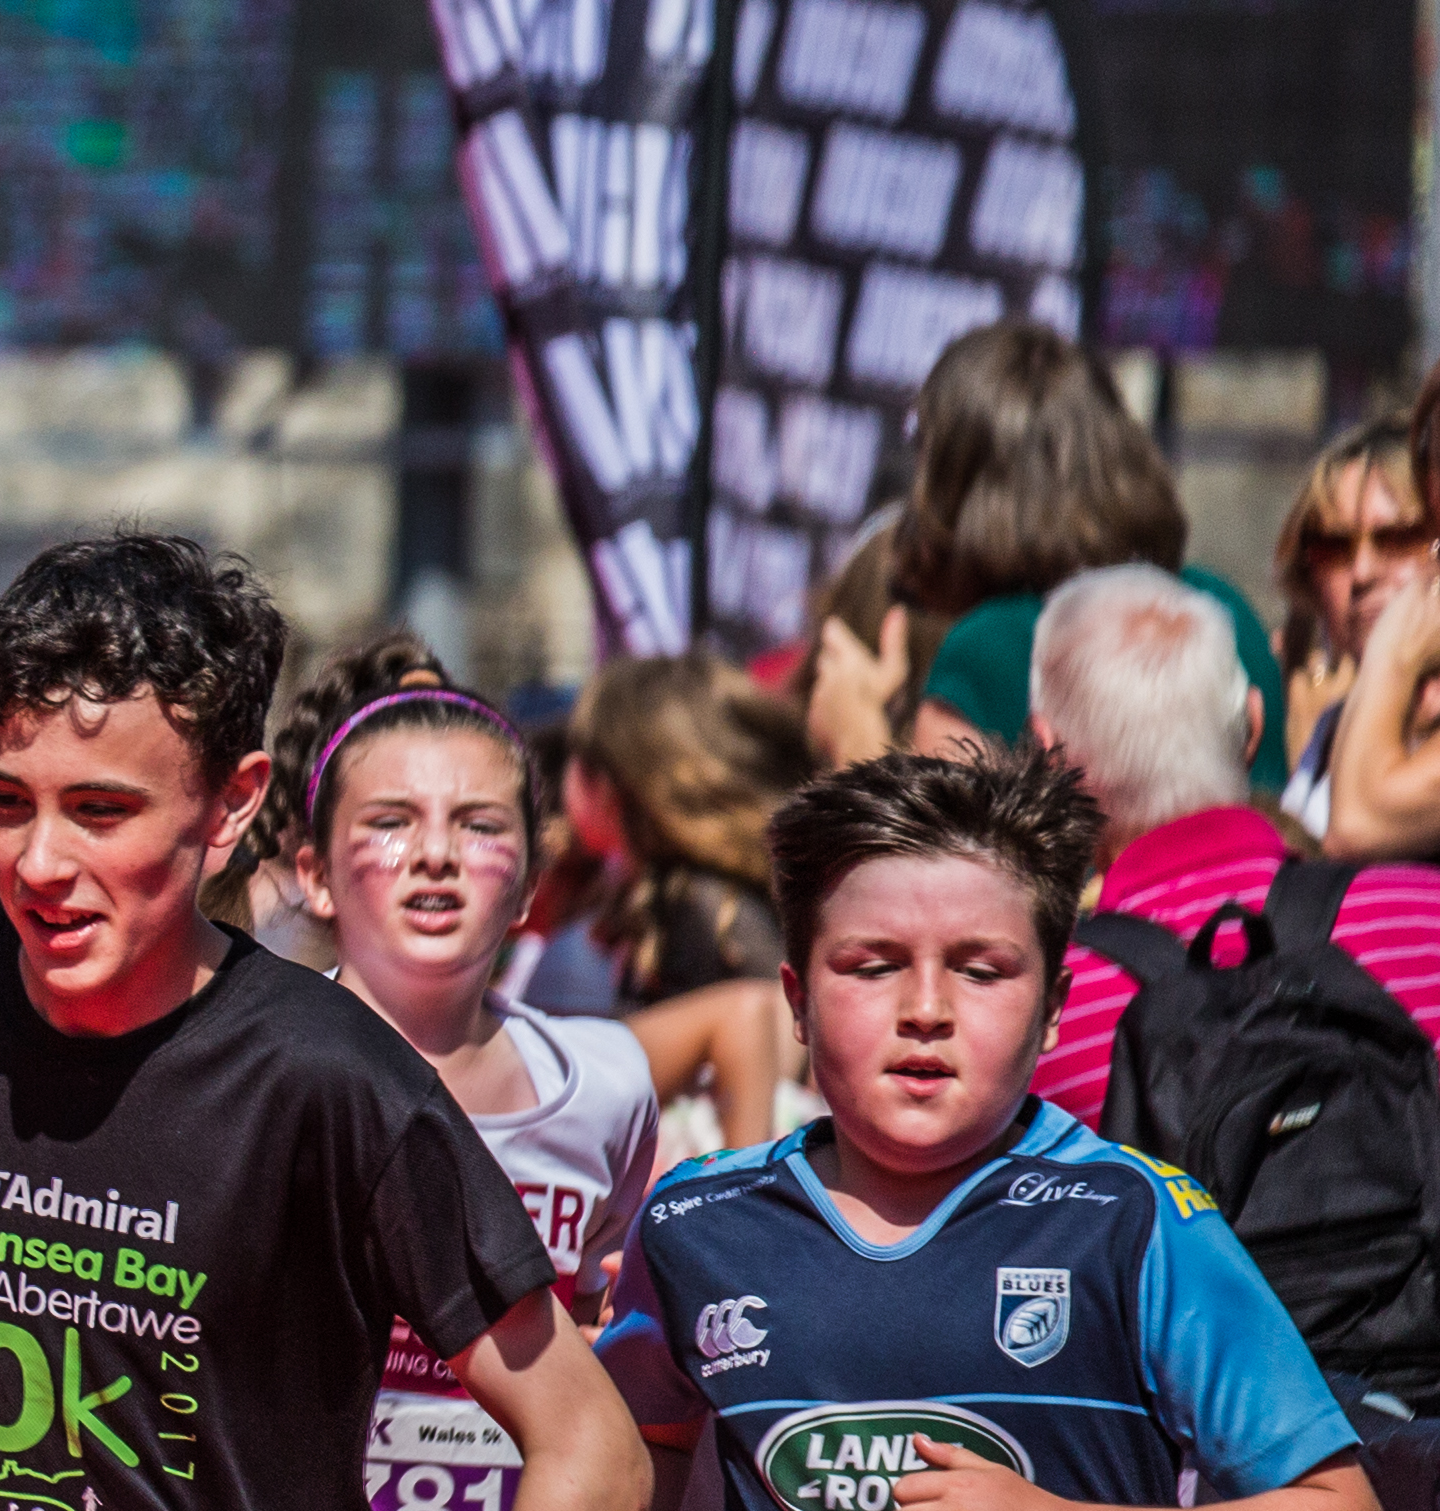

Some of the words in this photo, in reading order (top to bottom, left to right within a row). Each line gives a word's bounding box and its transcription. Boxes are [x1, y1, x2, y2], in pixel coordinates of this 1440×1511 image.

[0, 1172, 180, 1244] Admiral
[113, 1247, 208, 1310] Bay
[1002, 1280, 1066, 1293] BLUES
[157, 1350, 200, 1480] 2017
[418, 1424, 477, 1445] Wales
